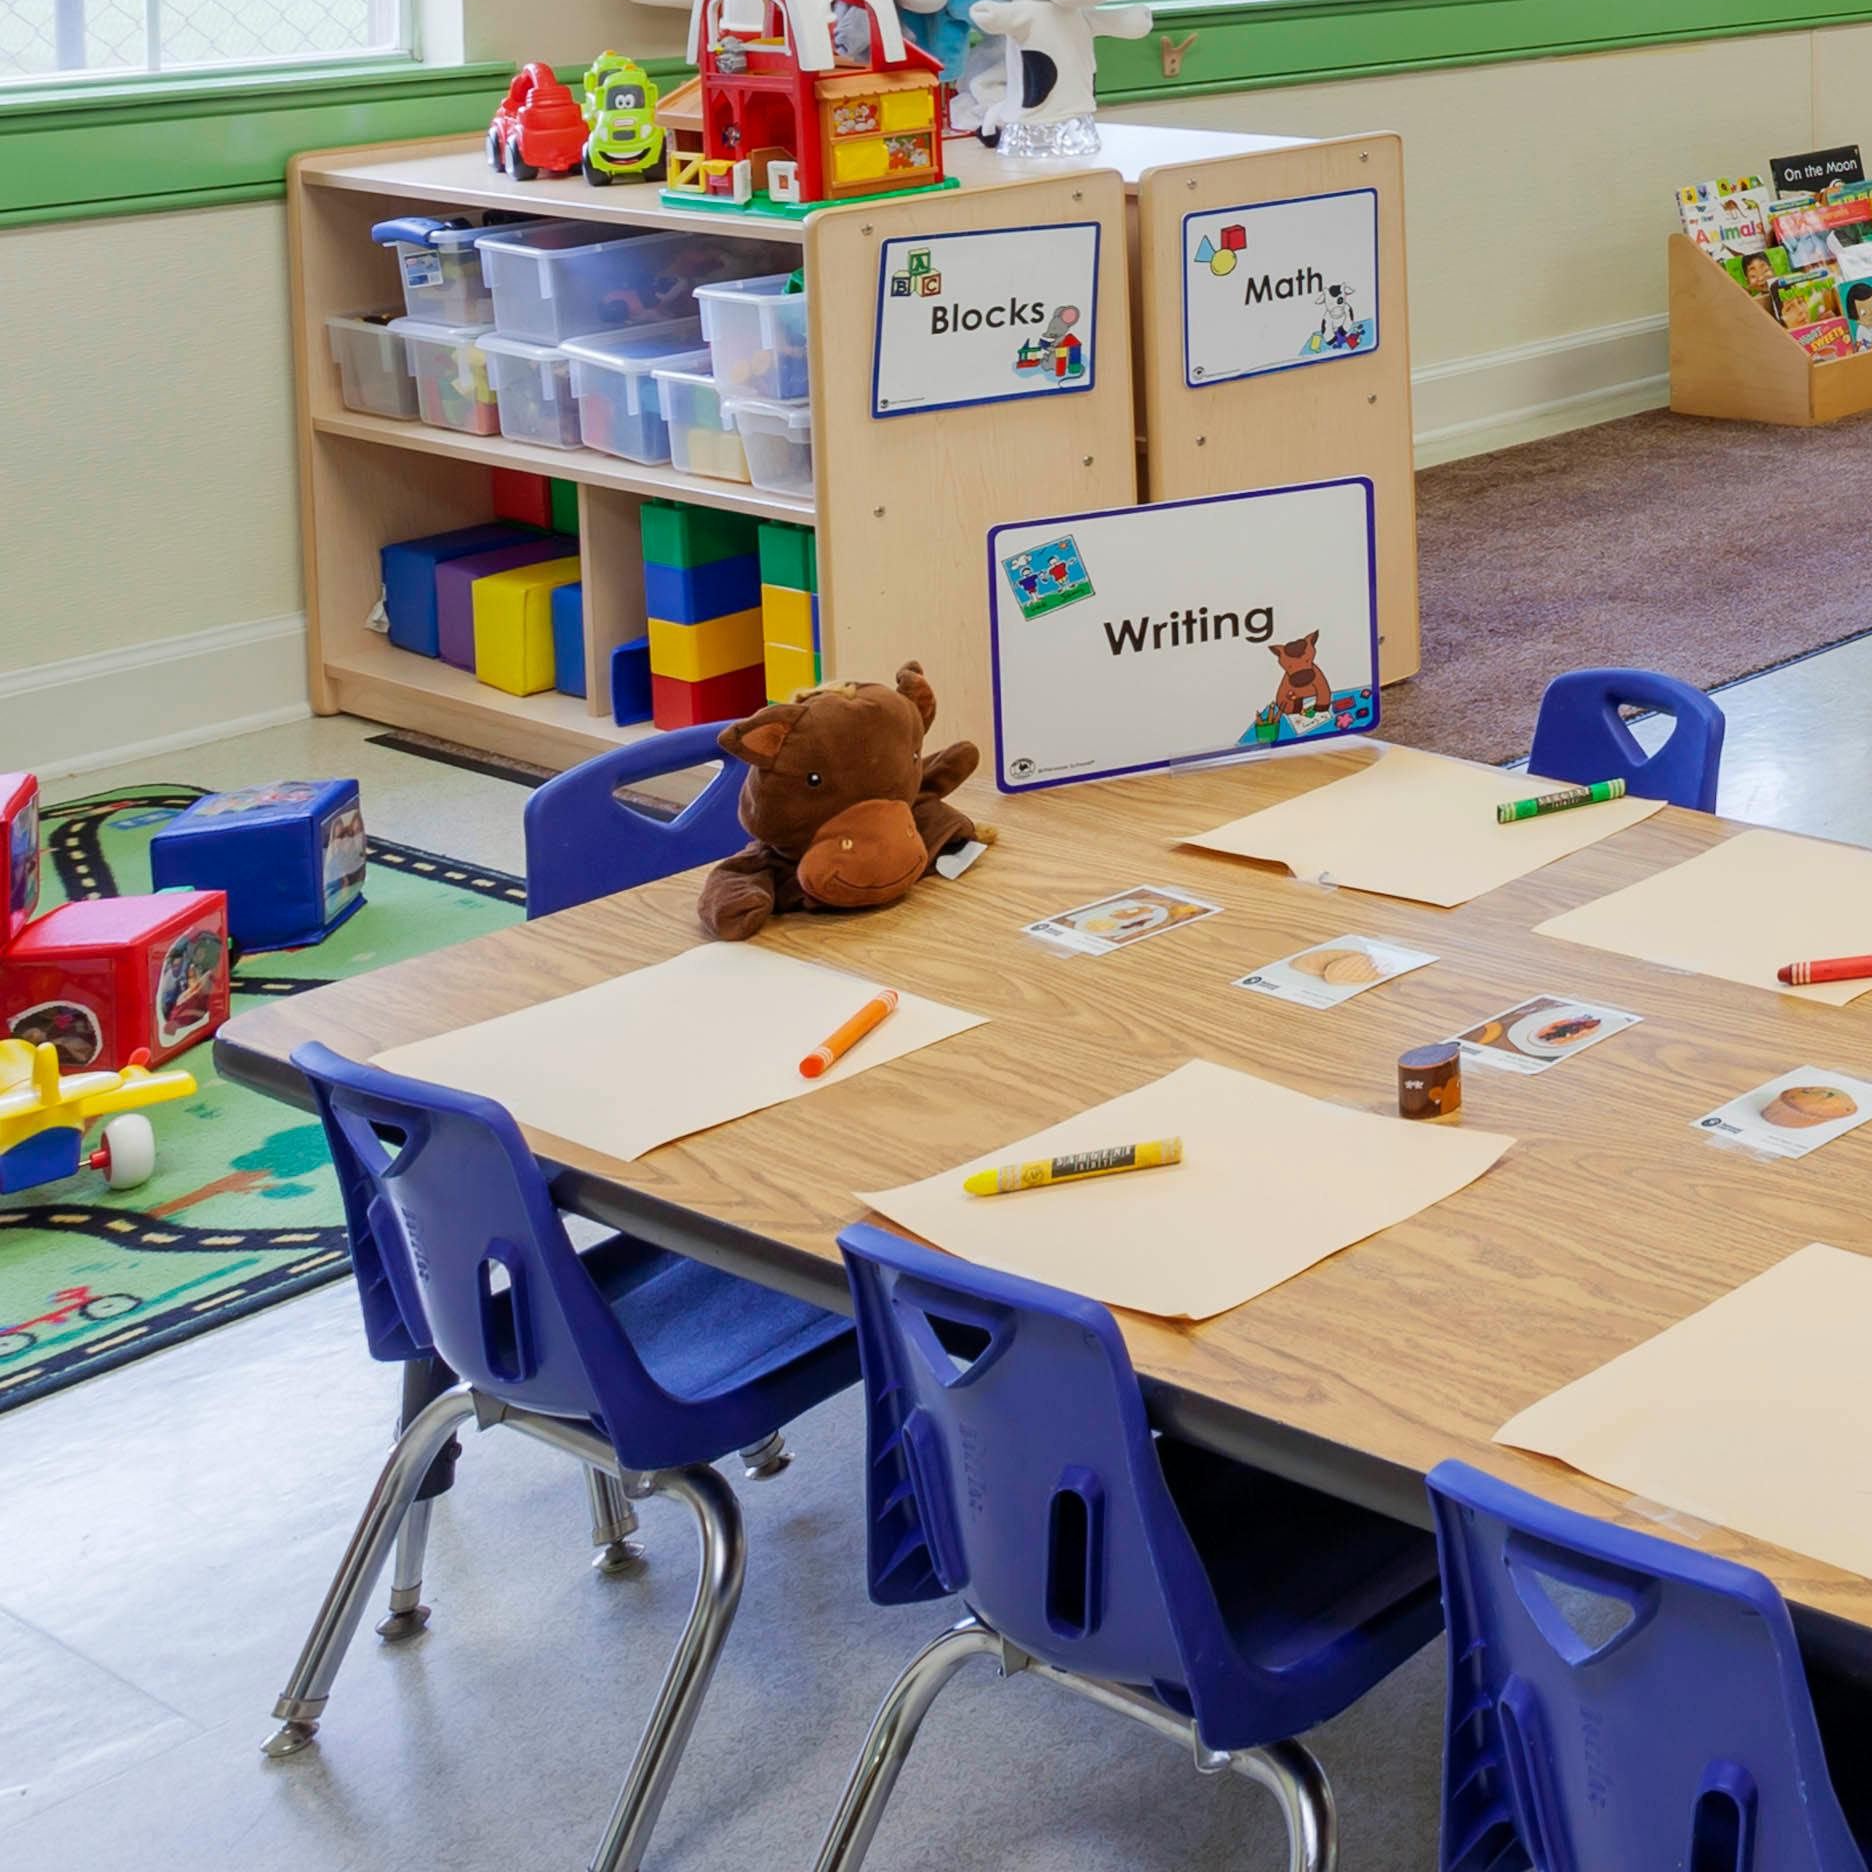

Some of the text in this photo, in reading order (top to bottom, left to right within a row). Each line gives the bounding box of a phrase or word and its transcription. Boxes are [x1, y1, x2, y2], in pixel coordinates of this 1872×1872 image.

[1783, 159, 1858, 182] On the Moon
[1695, 219, 1765, 245] Animals
[914, 254, 925, 271] A
[895, 279, 908, 295] B
[926, 278, 938, 293] C
[1244, 266, 1324, 306] Math
[931, 296, 1046, 335] Blocks
[1103, 605, 1276, 656] Writing
